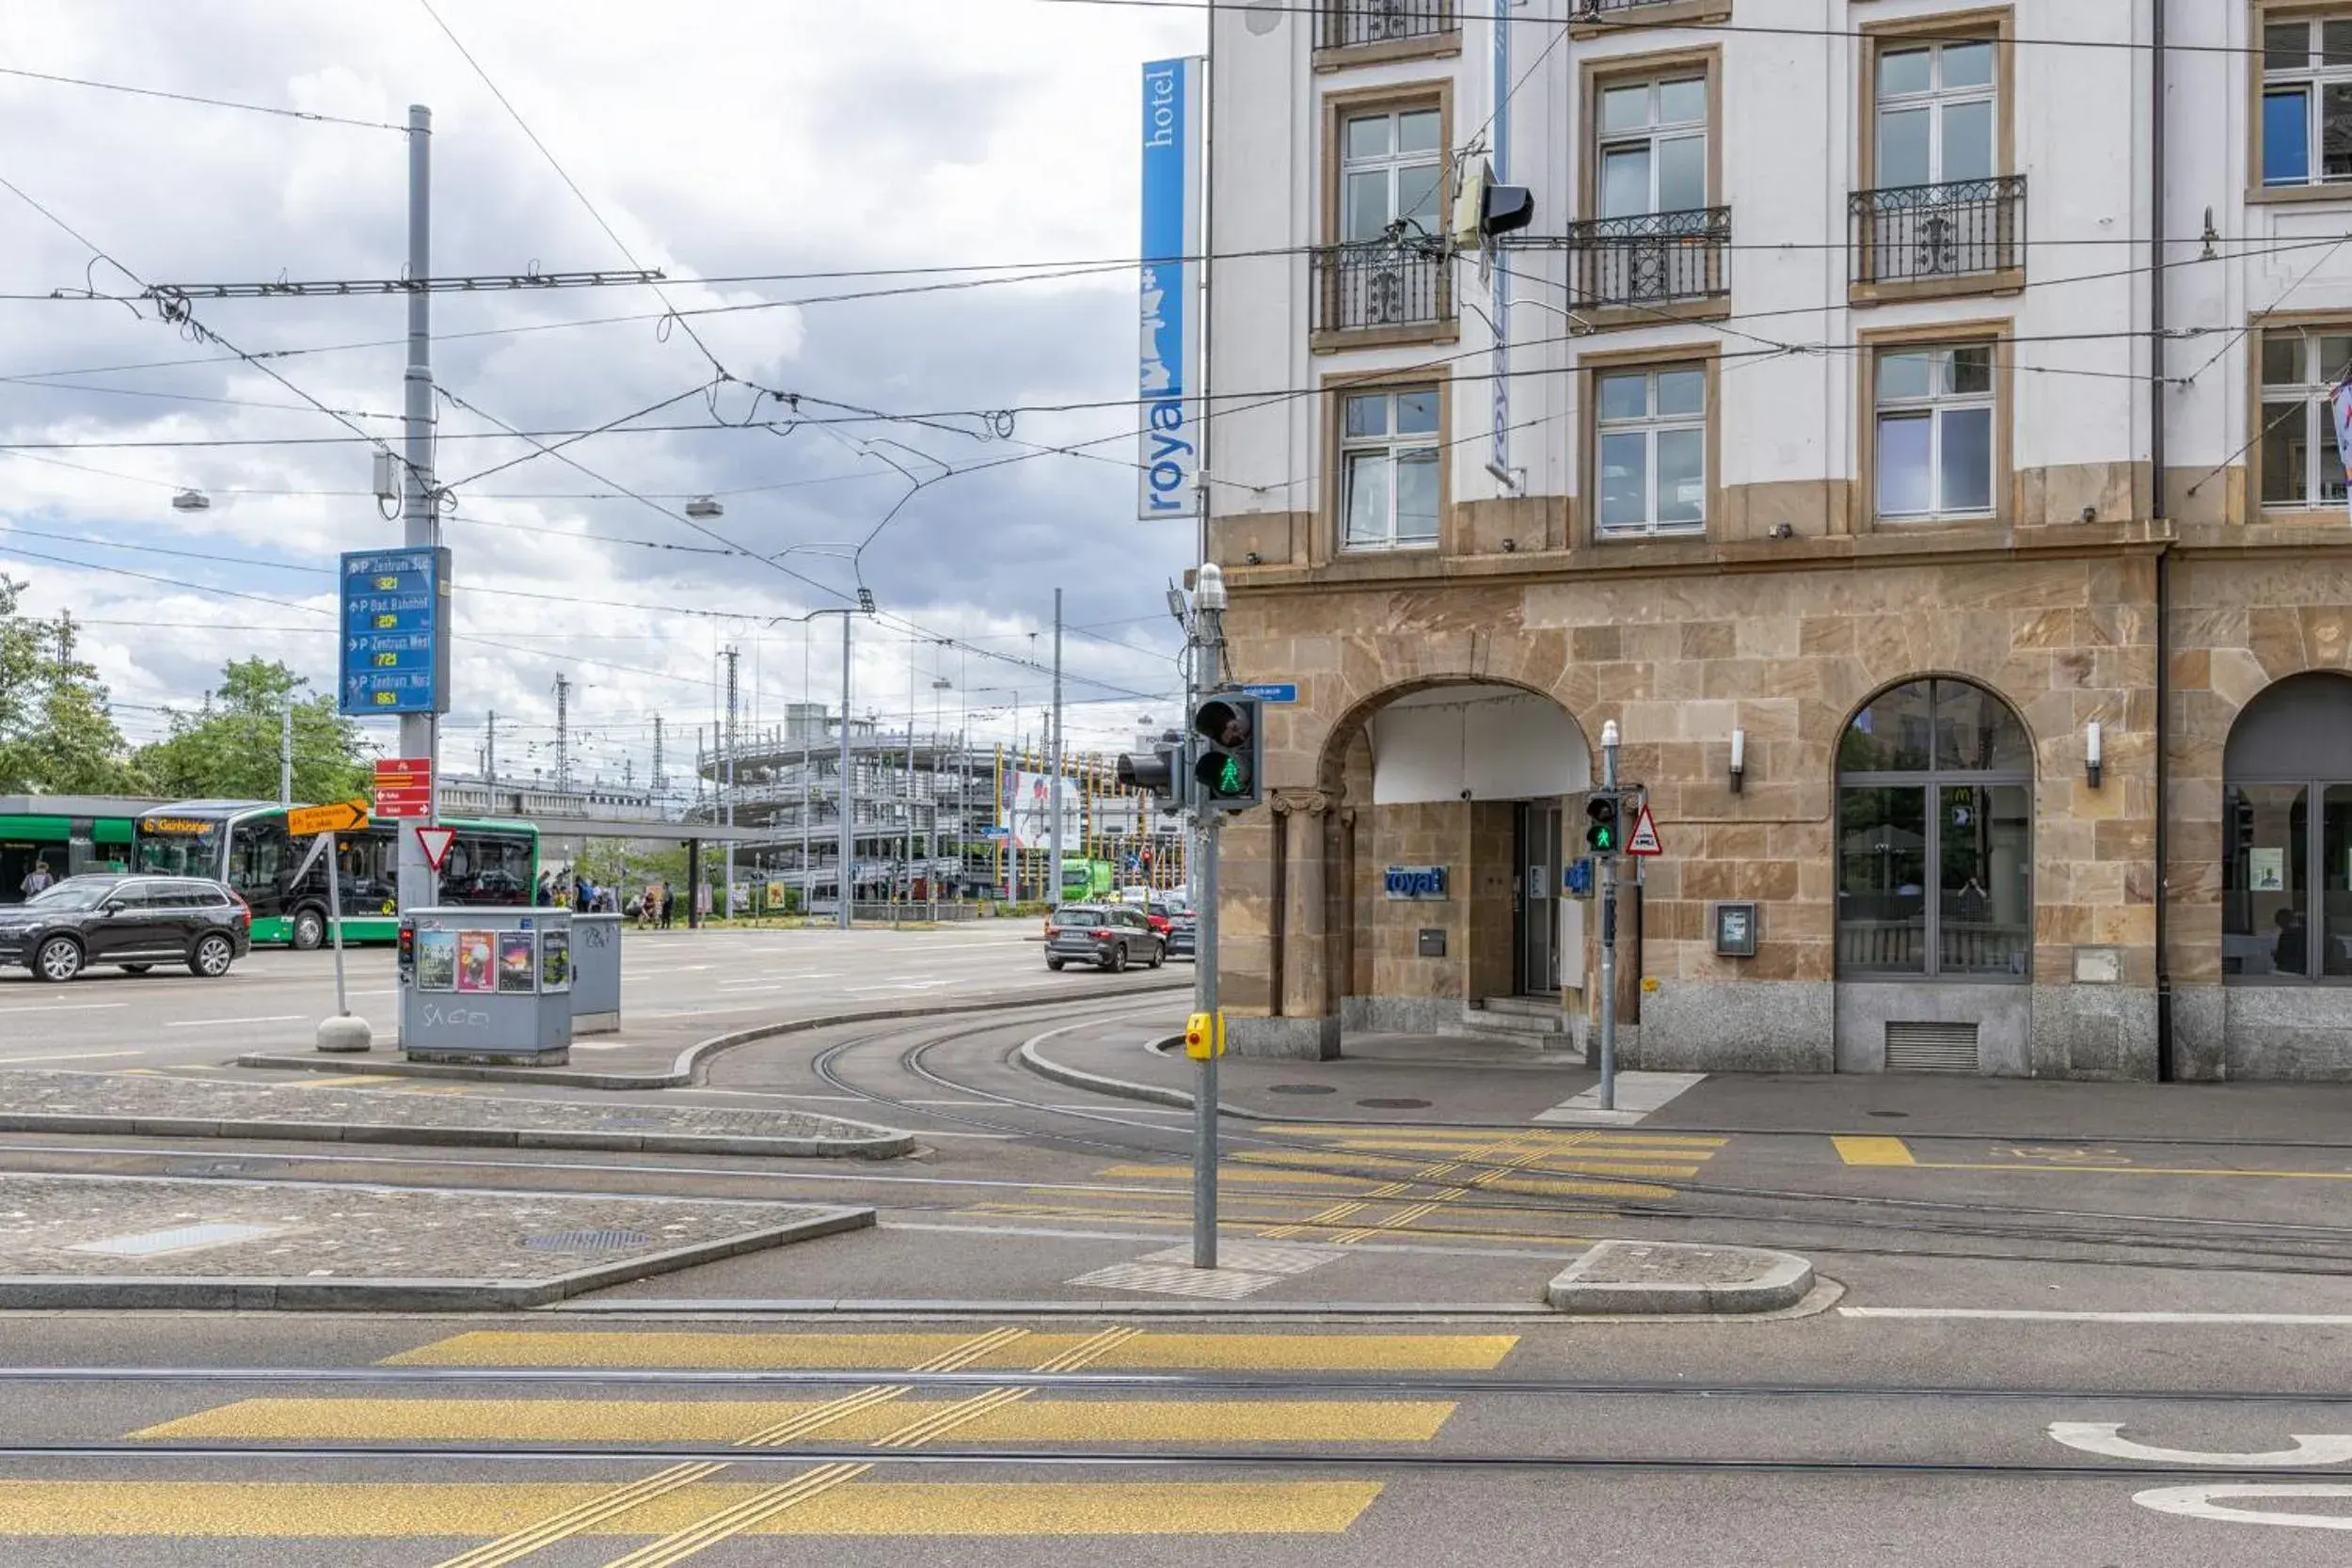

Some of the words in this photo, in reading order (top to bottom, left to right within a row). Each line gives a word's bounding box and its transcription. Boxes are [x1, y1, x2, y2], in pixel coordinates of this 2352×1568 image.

[1145, 69, 1173, 149] hotel
[1140, 388, 1193, 511] royal
[1385, 867, 1444, 896] royal
